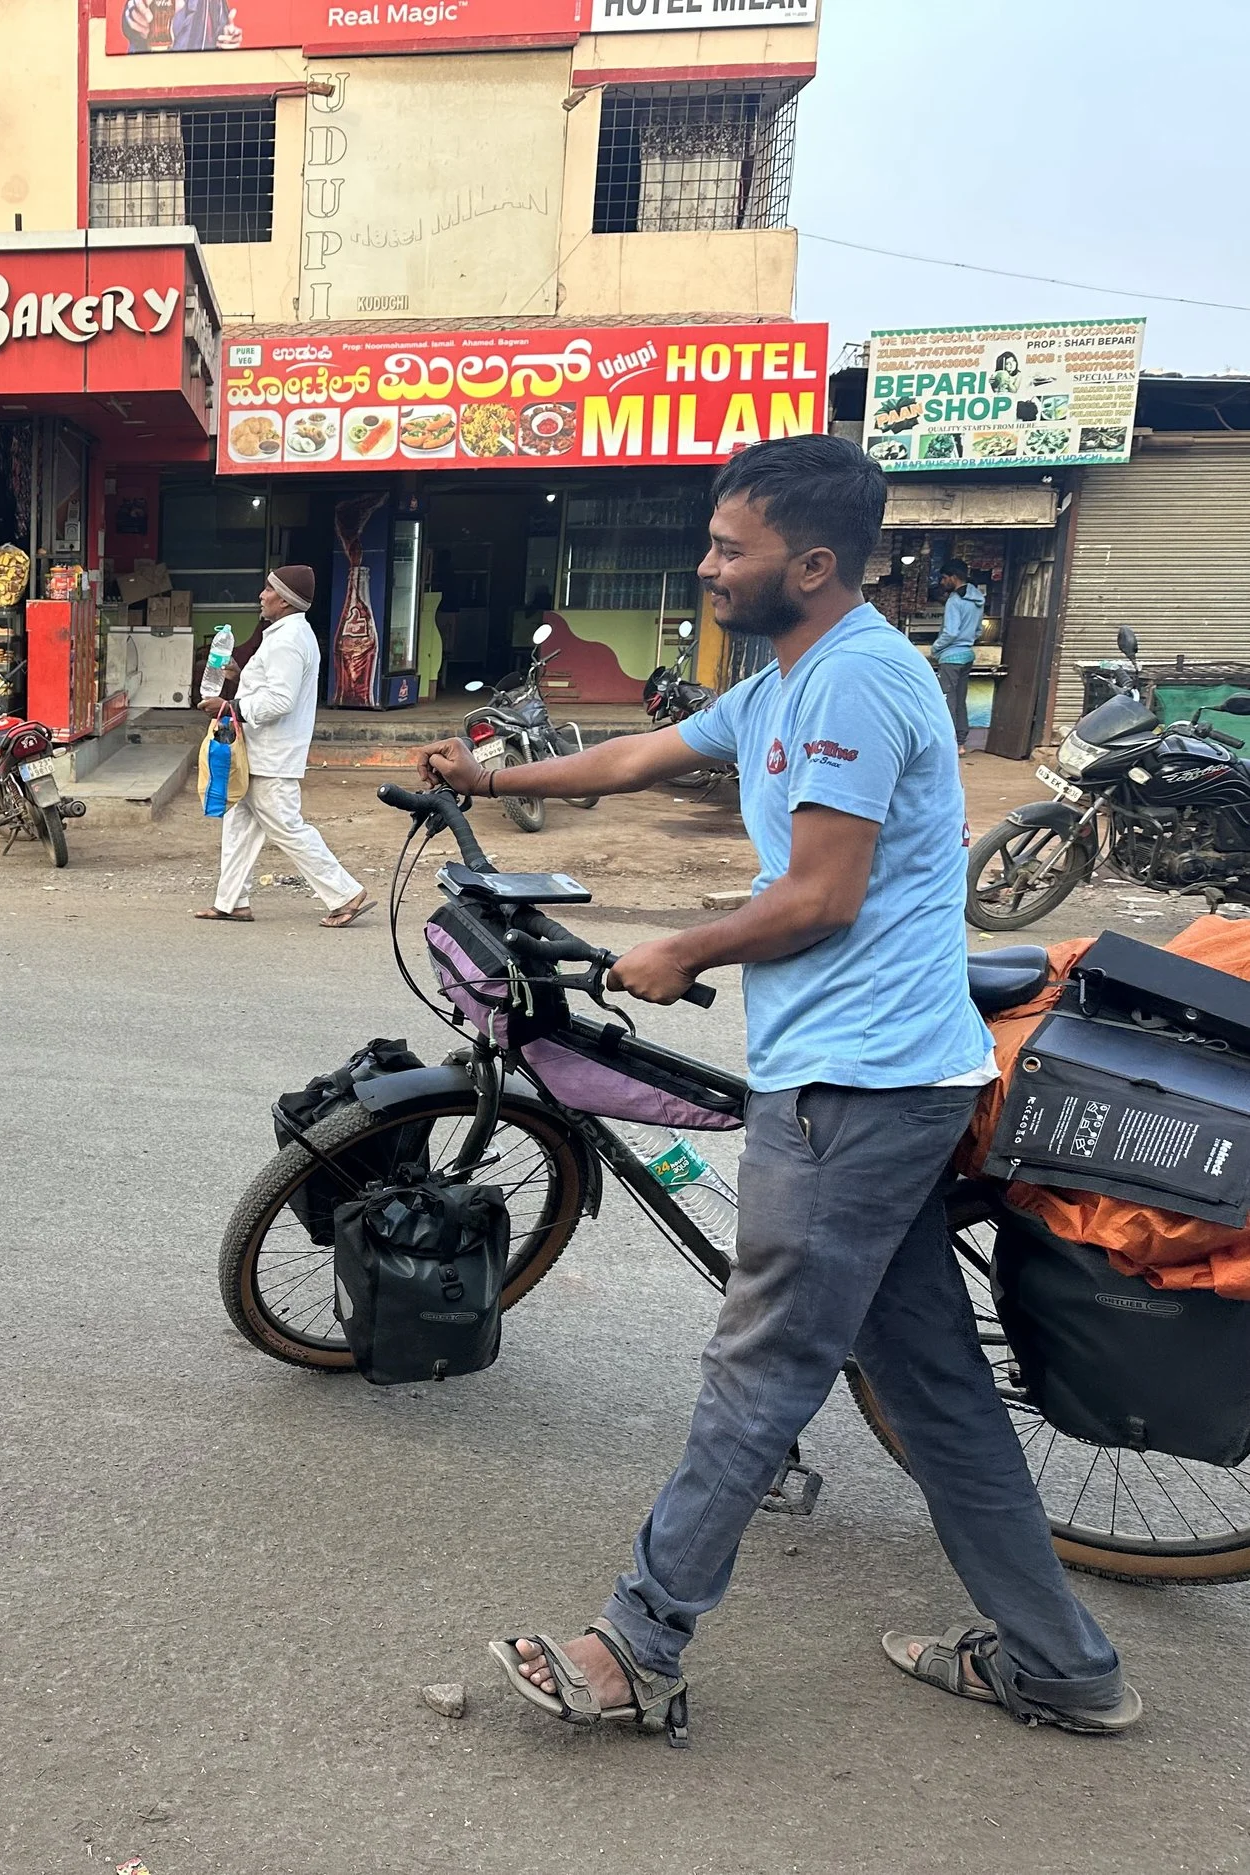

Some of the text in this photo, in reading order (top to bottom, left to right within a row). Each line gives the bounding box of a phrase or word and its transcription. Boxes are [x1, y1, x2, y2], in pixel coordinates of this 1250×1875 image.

[328, 7, 379, 26] Real
[357, 295, 410, 312] KUDUCHI
[900, 335, 927, 345] TAKE
[928, 334, 974, 344] SPECIAL
[977, 331, 1021, 341] ORDERS
[1024, 330, 1047, 339] FOR
[1049, 328, 1069, 338] ALL
[1027, 340, 1056, 349] PROP
[1064, 338, 1095, 348] SHAFI
[1097, 336, 1135, 345] BEPARI
[236, 347, 255, 355] PURE
[272, 343, 333, 361] ಉಡುಪಿ
[342, 343, 363, 351] Prop:
[238, 357, 253, 365] VEG
[597, 340, 658, 380] Udupi
[666, 342, 817, 382] HOTEL
[377, 338, 593, 401] ಮಿಲನ್
[1073, 371, 1137, 382] SPECIAL PAN
[874, 371, 987, 399] BEPARI
[876, 401, 925, 427] PAAN
[923, 396, 1012, 423] SHOP
[581, 391, 815, 457] MILAN
[927, 425, 960, 434] QUALITY
[962, 424, 991, 432] STARTS
[993, 423, 1015, 431] FROM
[654, 1160, 671, 1176] 24
